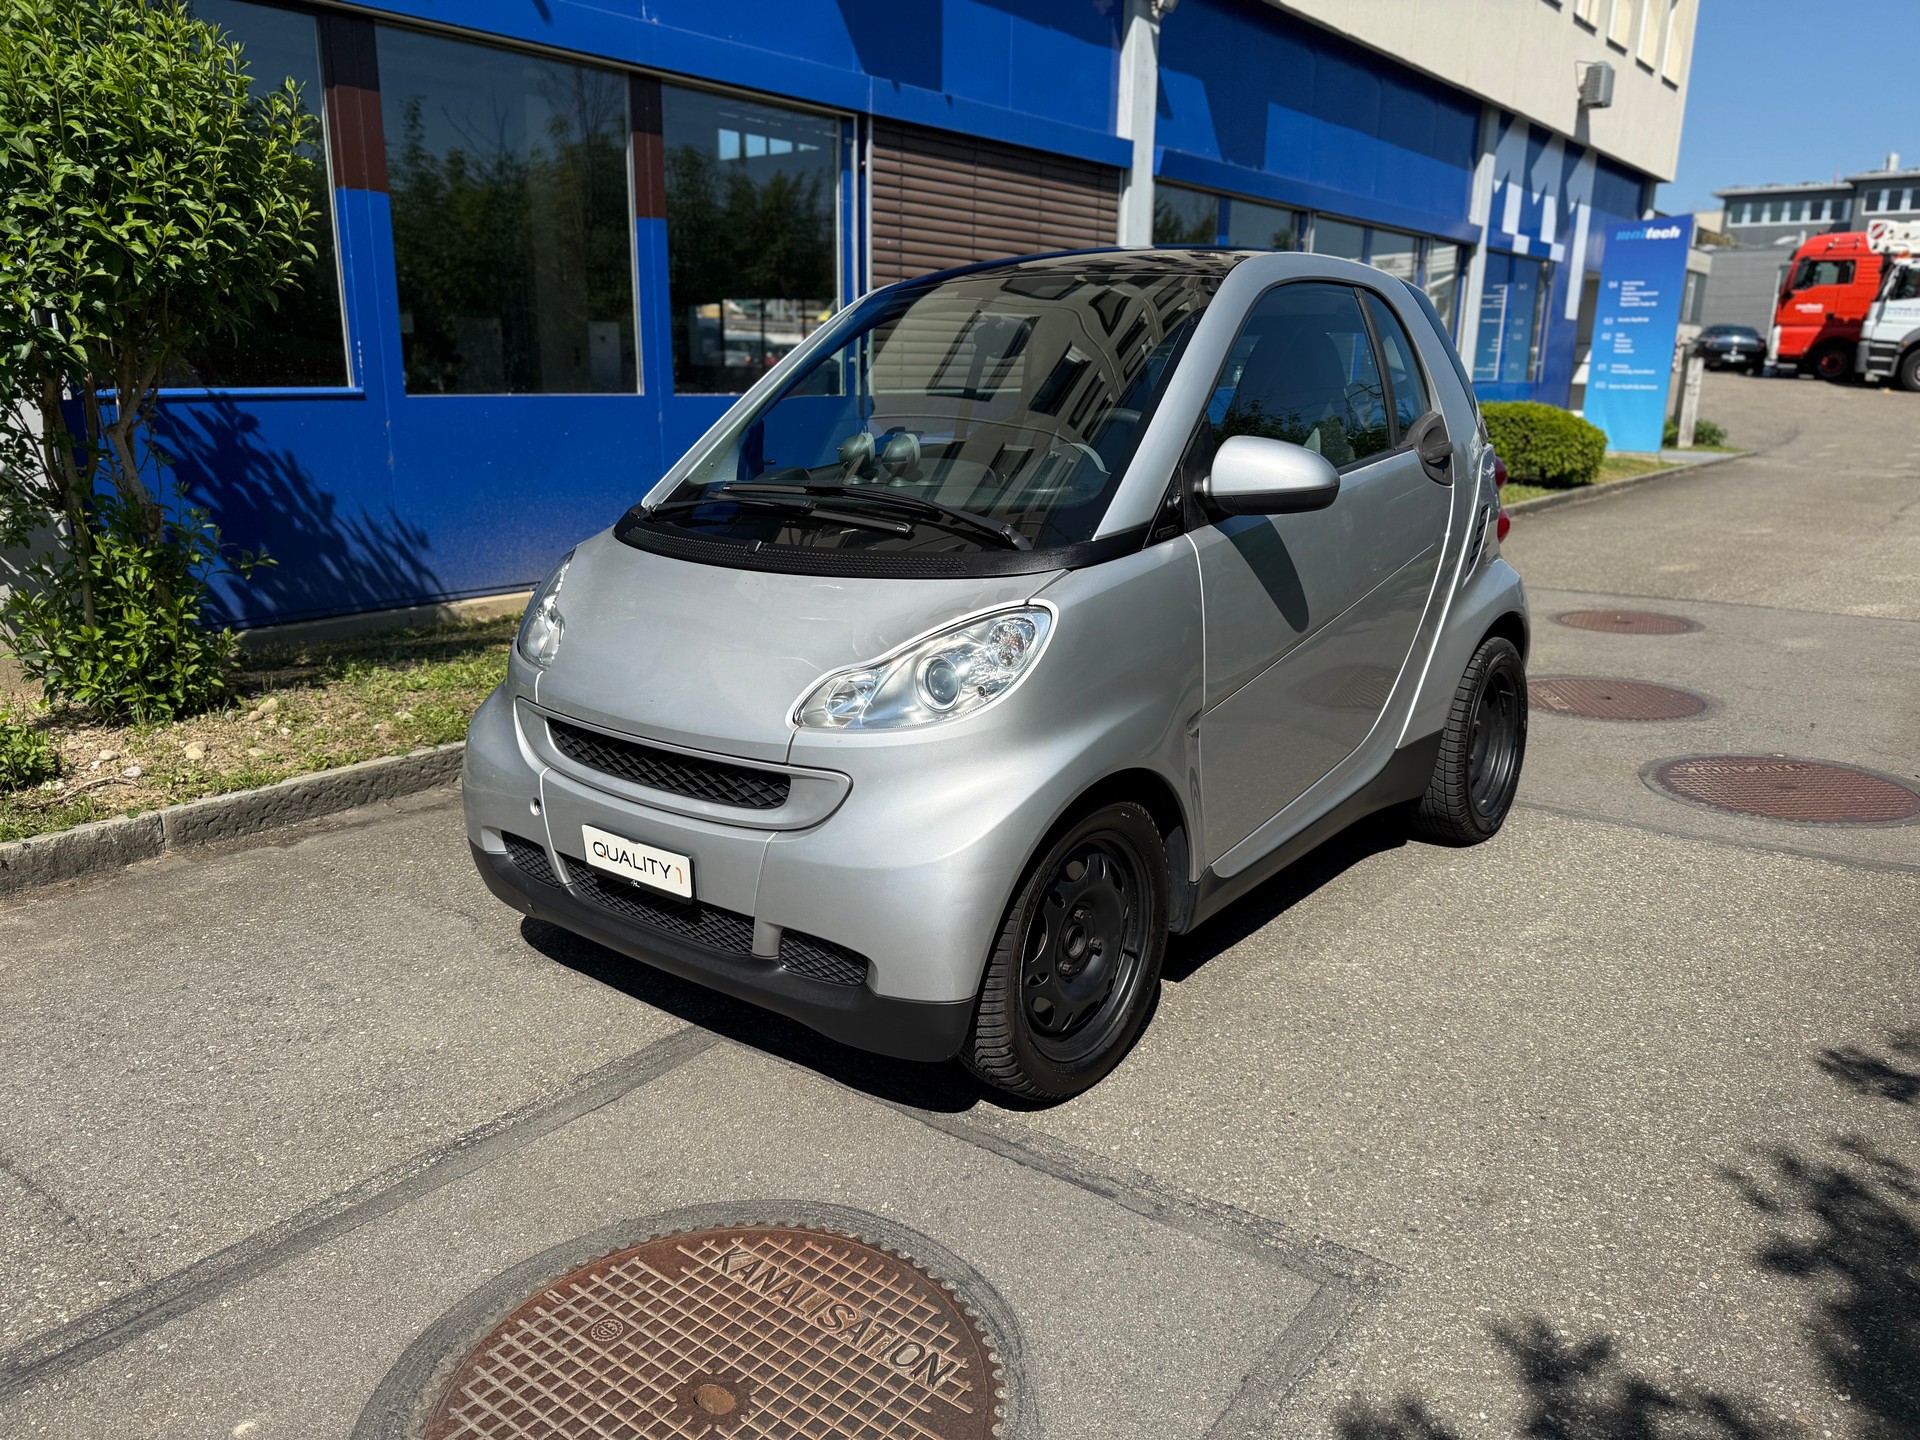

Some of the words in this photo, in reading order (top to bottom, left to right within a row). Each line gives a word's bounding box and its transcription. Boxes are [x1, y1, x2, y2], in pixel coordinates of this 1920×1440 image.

[593, 841, 671, 879] QUALITY
[675, 866, 683, 884] 1
[713, 1247, 957, 1386] KANALISATION
